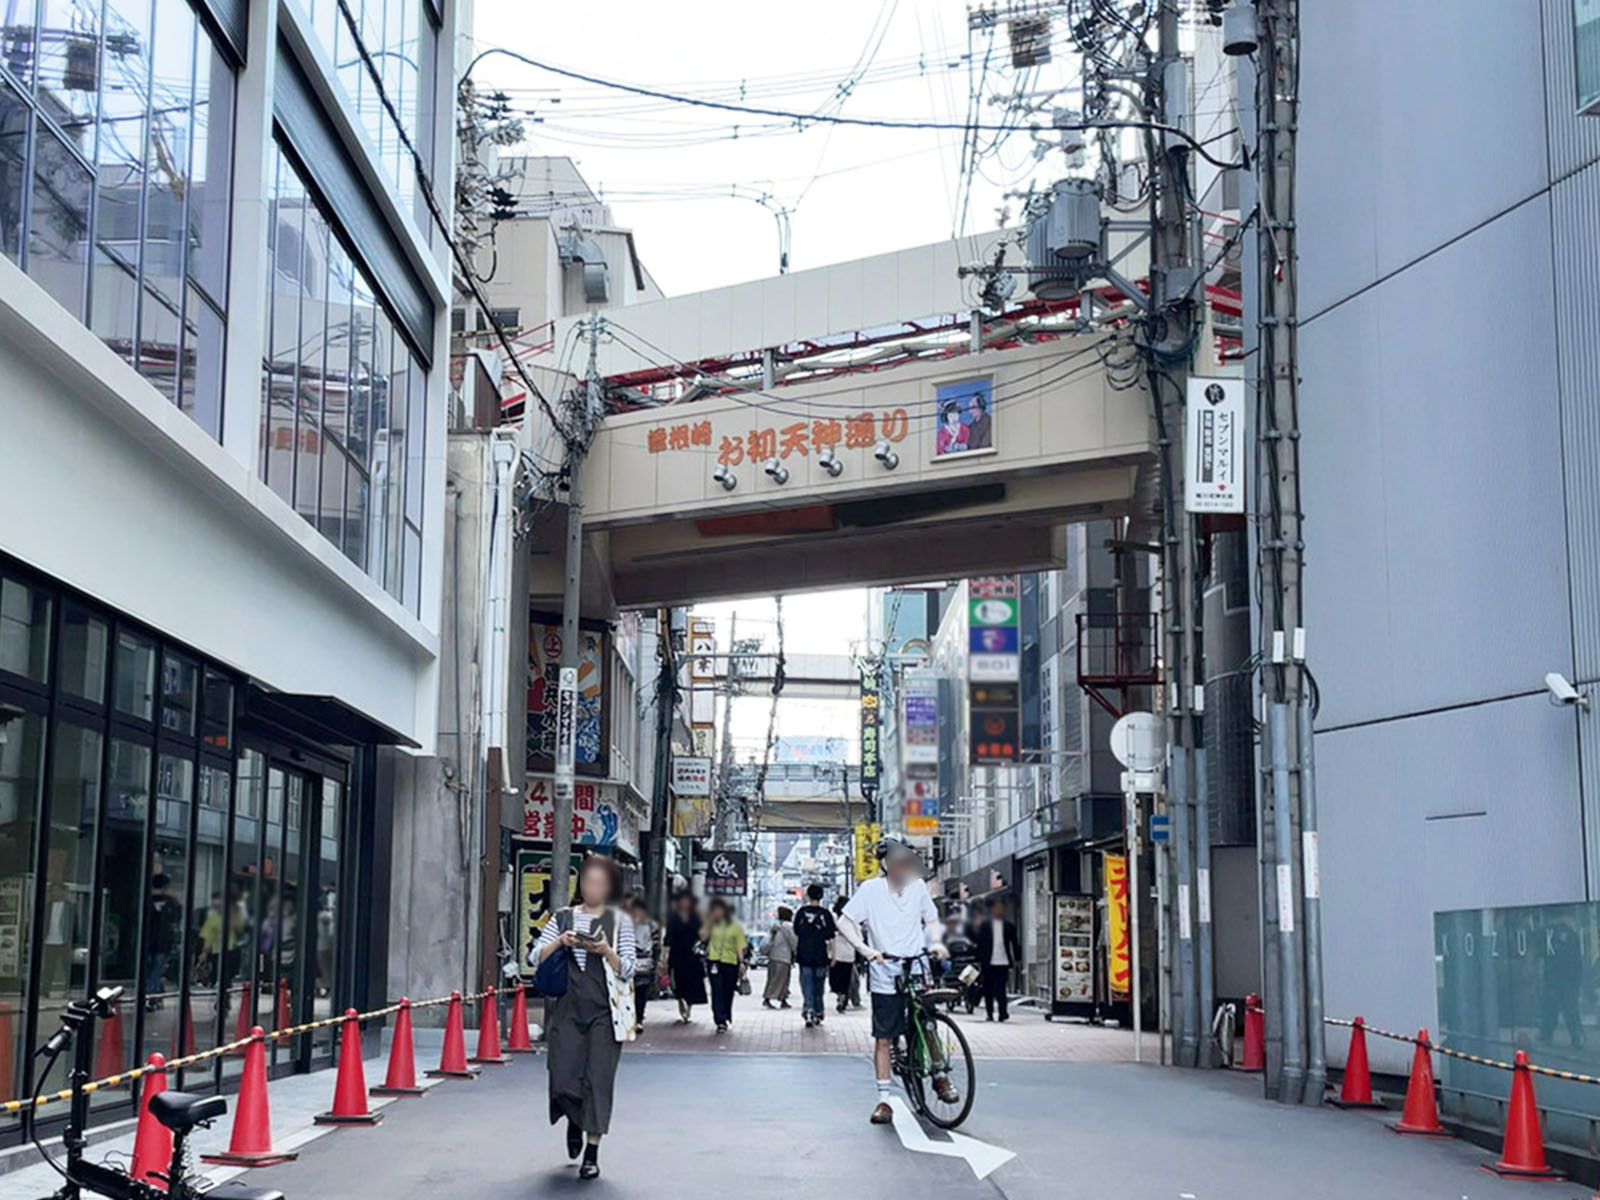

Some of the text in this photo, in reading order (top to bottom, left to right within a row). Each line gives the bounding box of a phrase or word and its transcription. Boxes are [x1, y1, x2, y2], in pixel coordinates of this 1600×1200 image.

[718, 408, 910, 467] お初天神通り
[1217, 412, 1230, 481] セブンマルイ
[1441, 928, 1585, 957] KOZUKI
